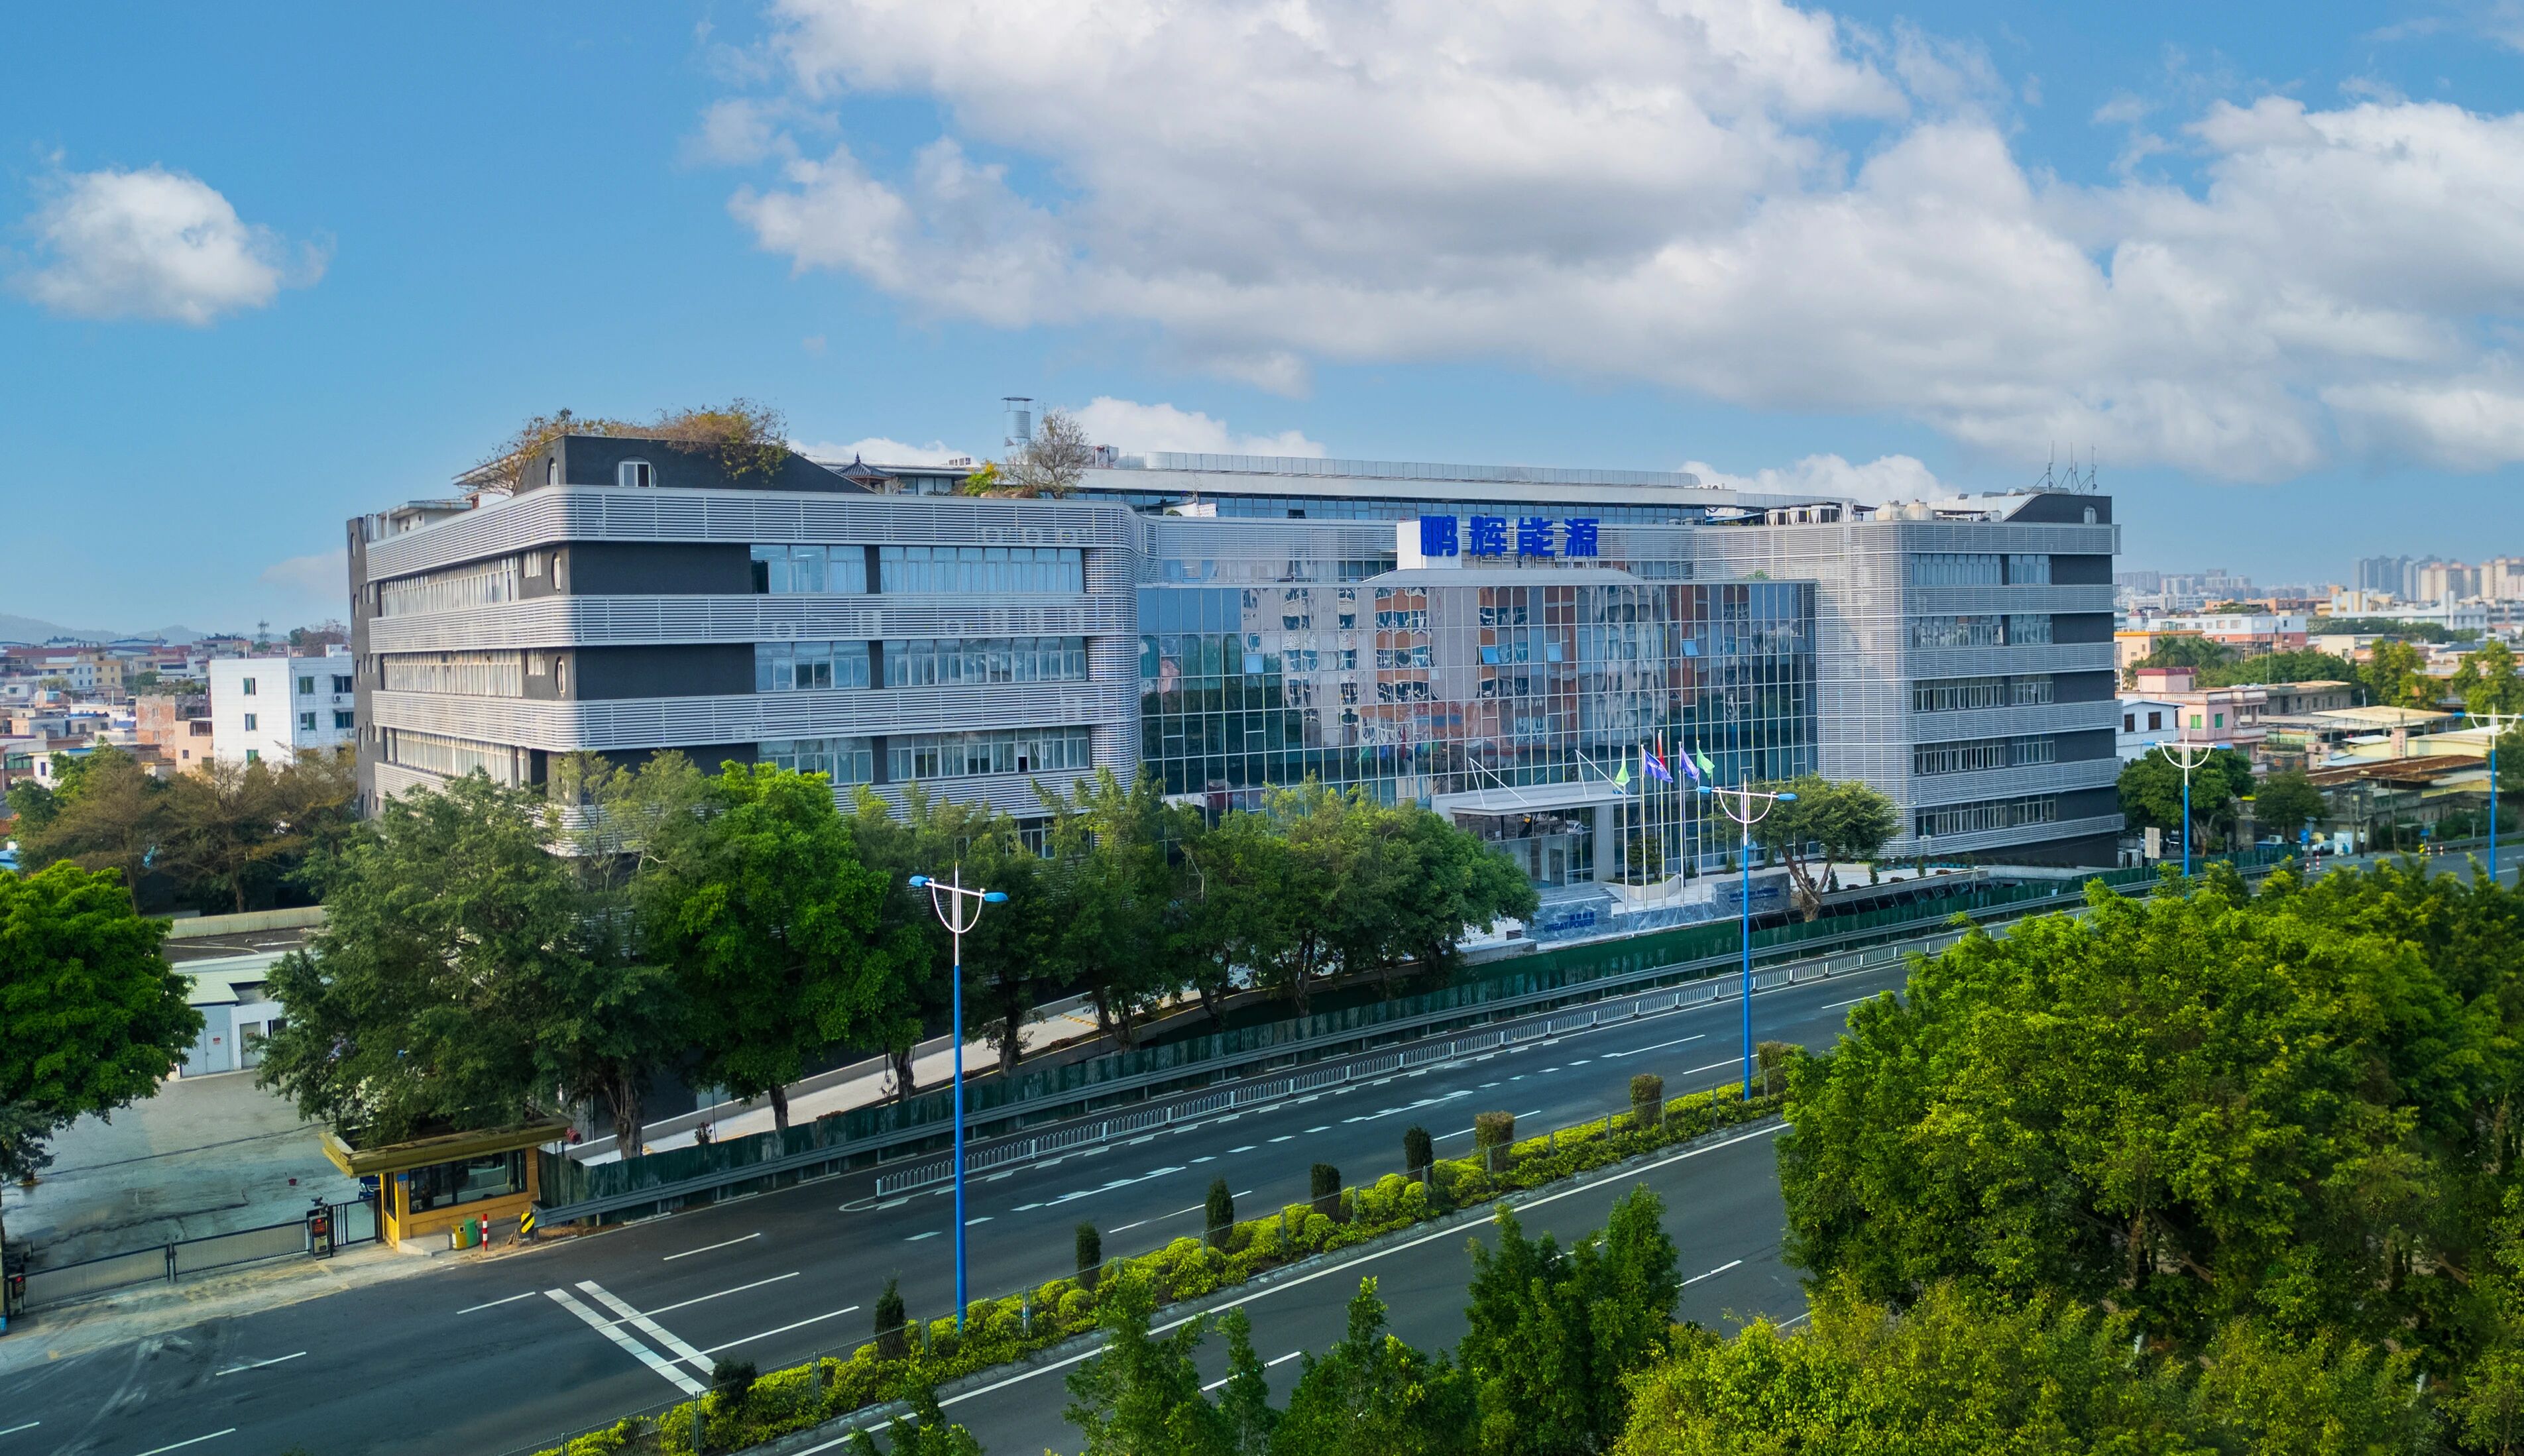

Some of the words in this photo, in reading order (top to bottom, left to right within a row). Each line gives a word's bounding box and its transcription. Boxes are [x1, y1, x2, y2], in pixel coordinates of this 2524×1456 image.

[1420, 516, 1599, 556] 鹏辉能源
[1544, 922, 1568, 932] GREAT
[1570, 919, 1595, 928] POWER
